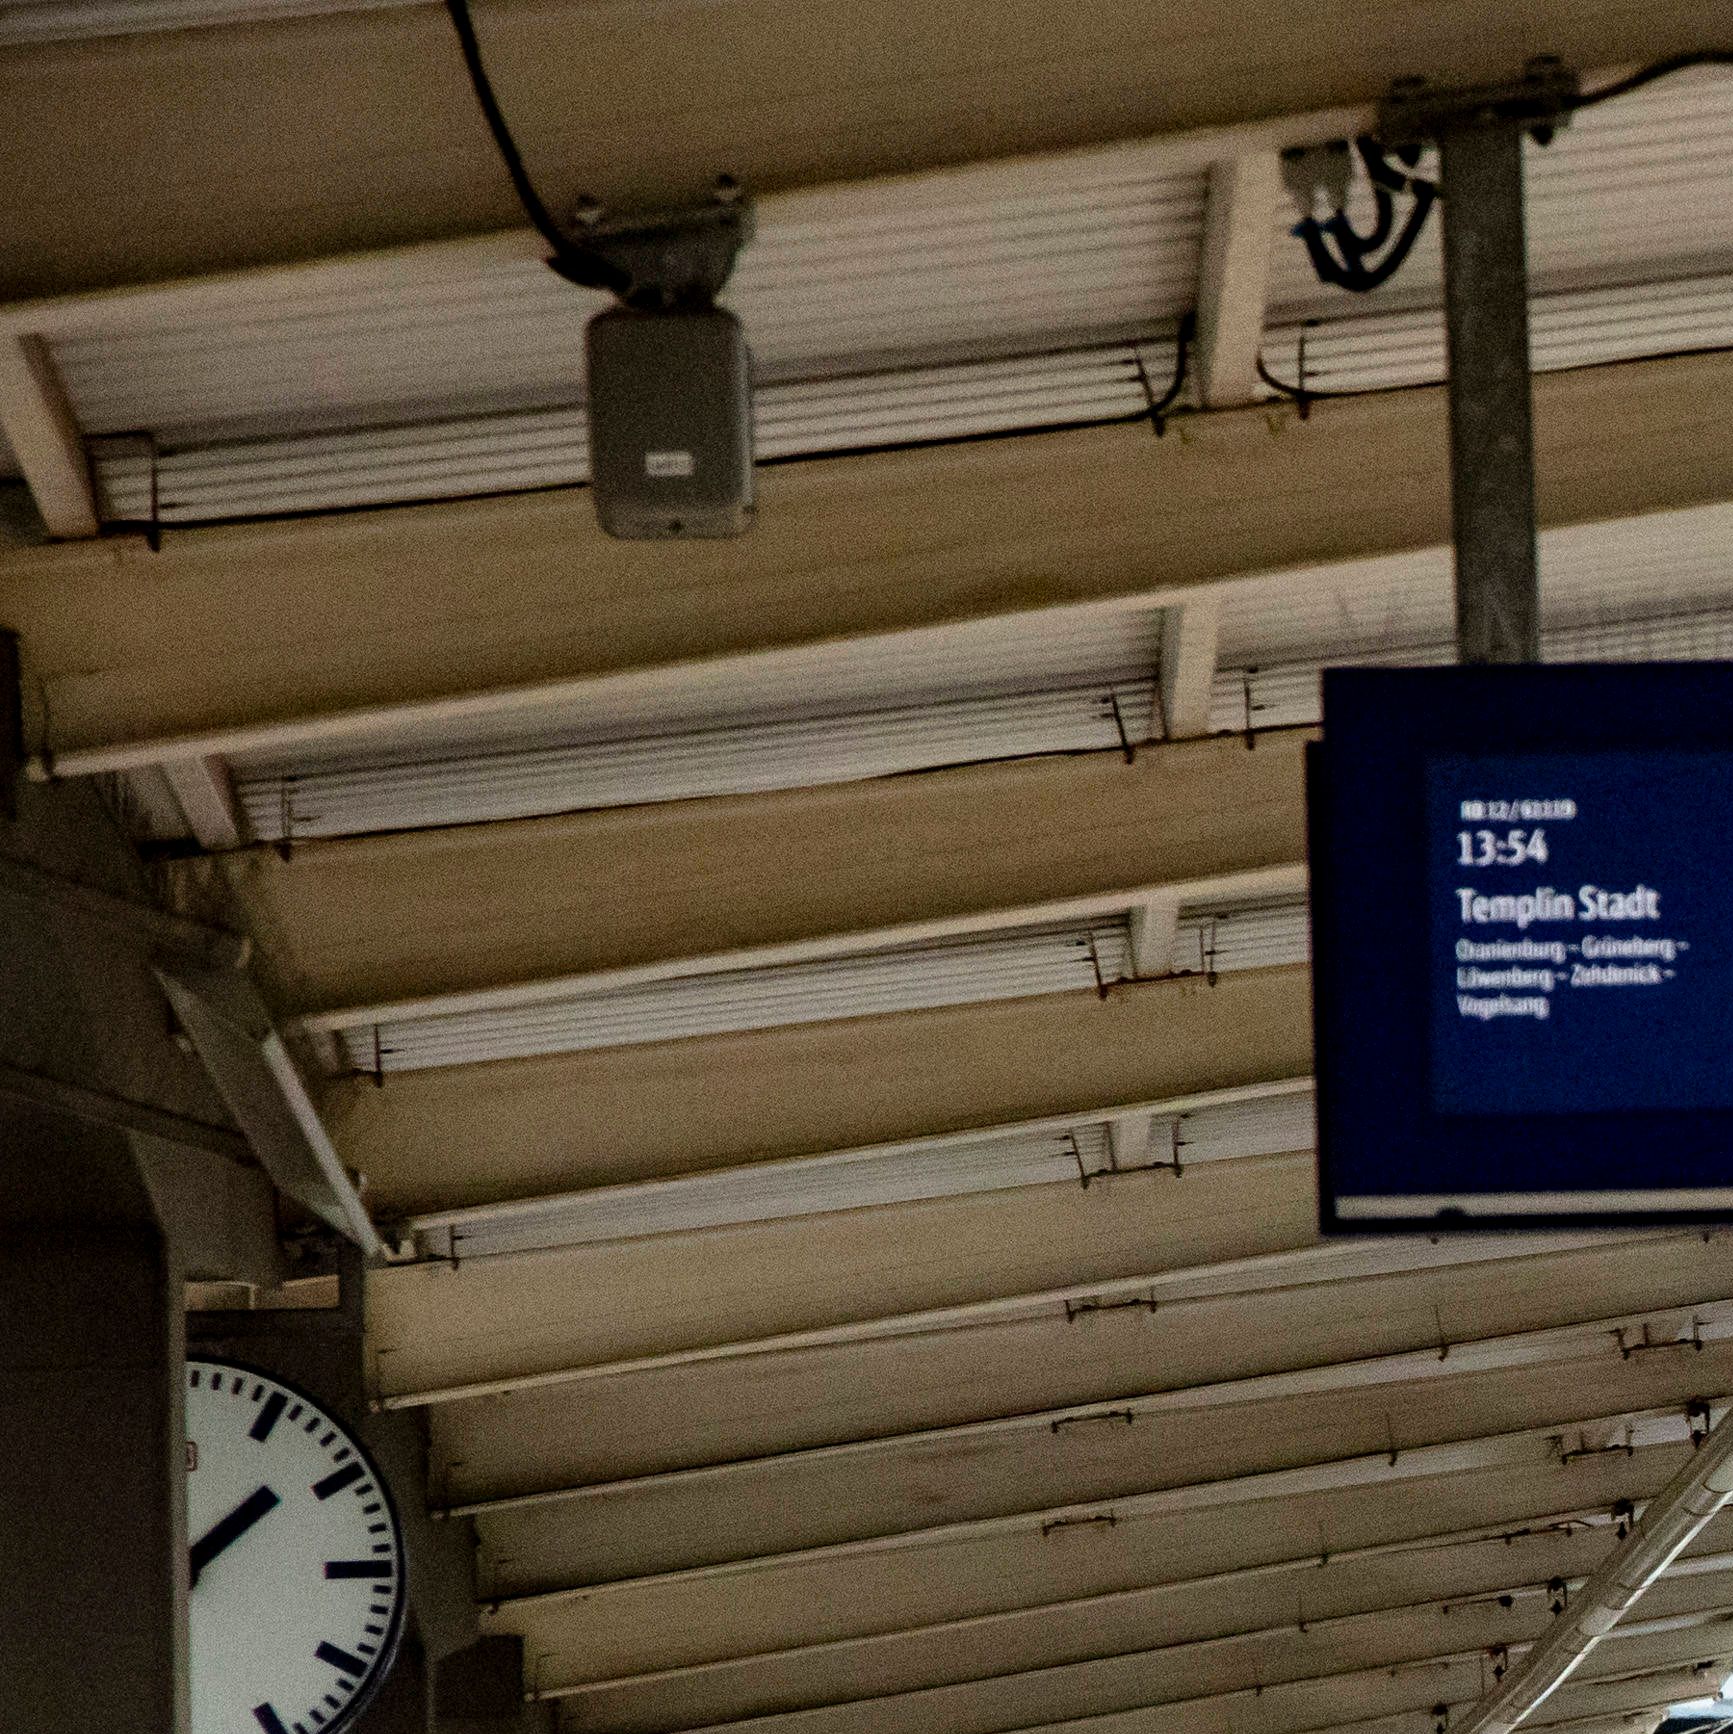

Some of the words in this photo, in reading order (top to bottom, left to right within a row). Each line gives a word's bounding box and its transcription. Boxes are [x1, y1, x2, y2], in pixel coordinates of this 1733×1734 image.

[1458, 829, 1548, 866] 13:54
[1456, 887, 1574, 928] Templin
[1579, 885, 1660, 921] Stadt
